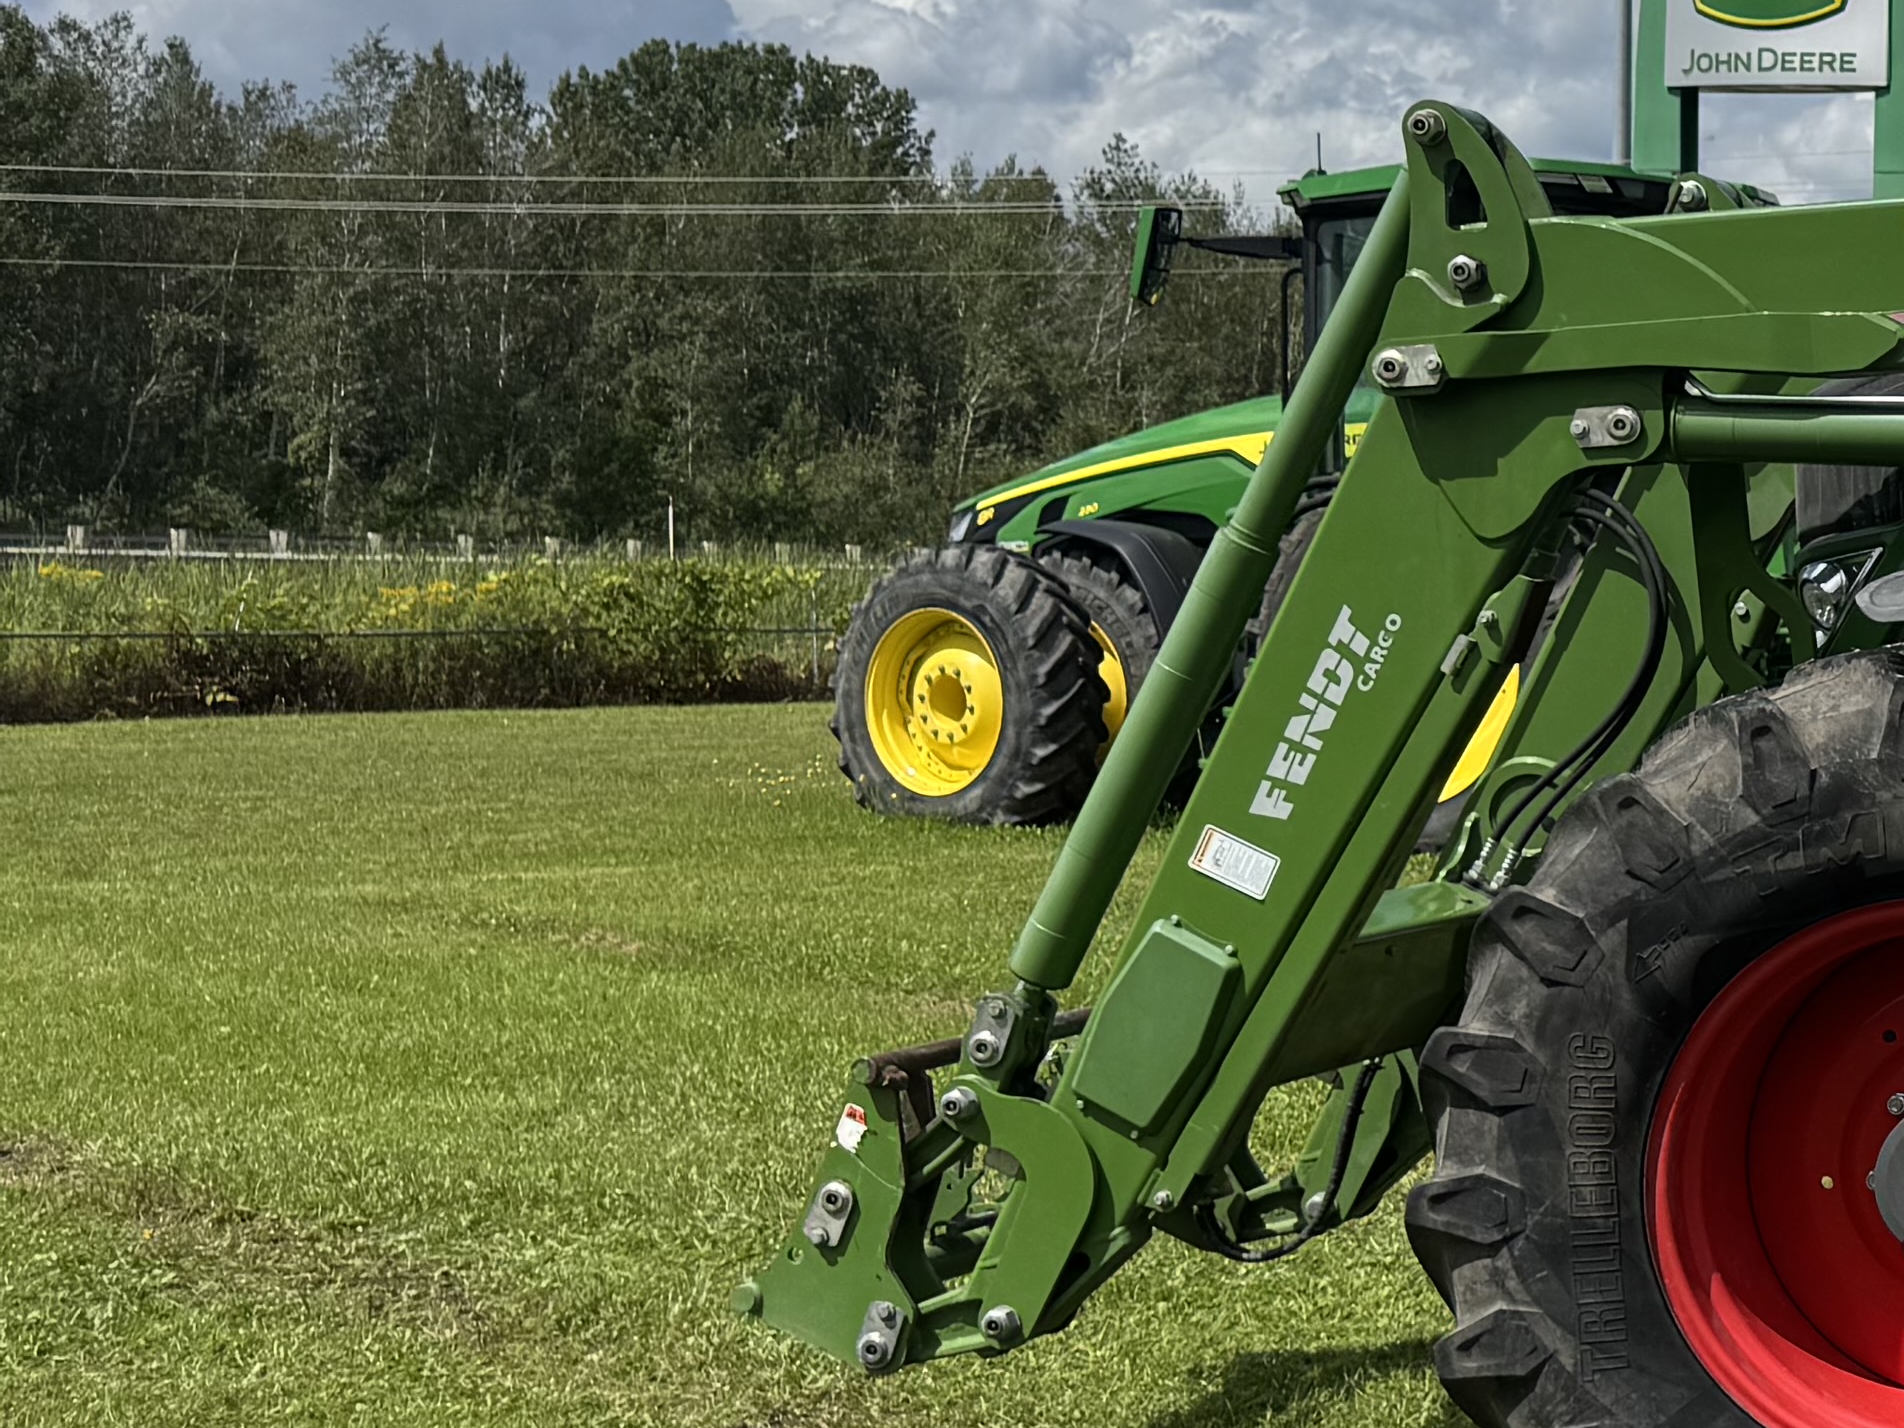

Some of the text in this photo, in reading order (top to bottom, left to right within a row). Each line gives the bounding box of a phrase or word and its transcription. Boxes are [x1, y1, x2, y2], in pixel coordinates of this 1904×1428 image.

[1680, 47, 1857, 76] JOHN DEERE
[1248, 604, 1371, 820] FENDT
[1357, 613, 1402, 692] CARGO
[1566, 1031, 1631, 1384] TRELLEBORG
